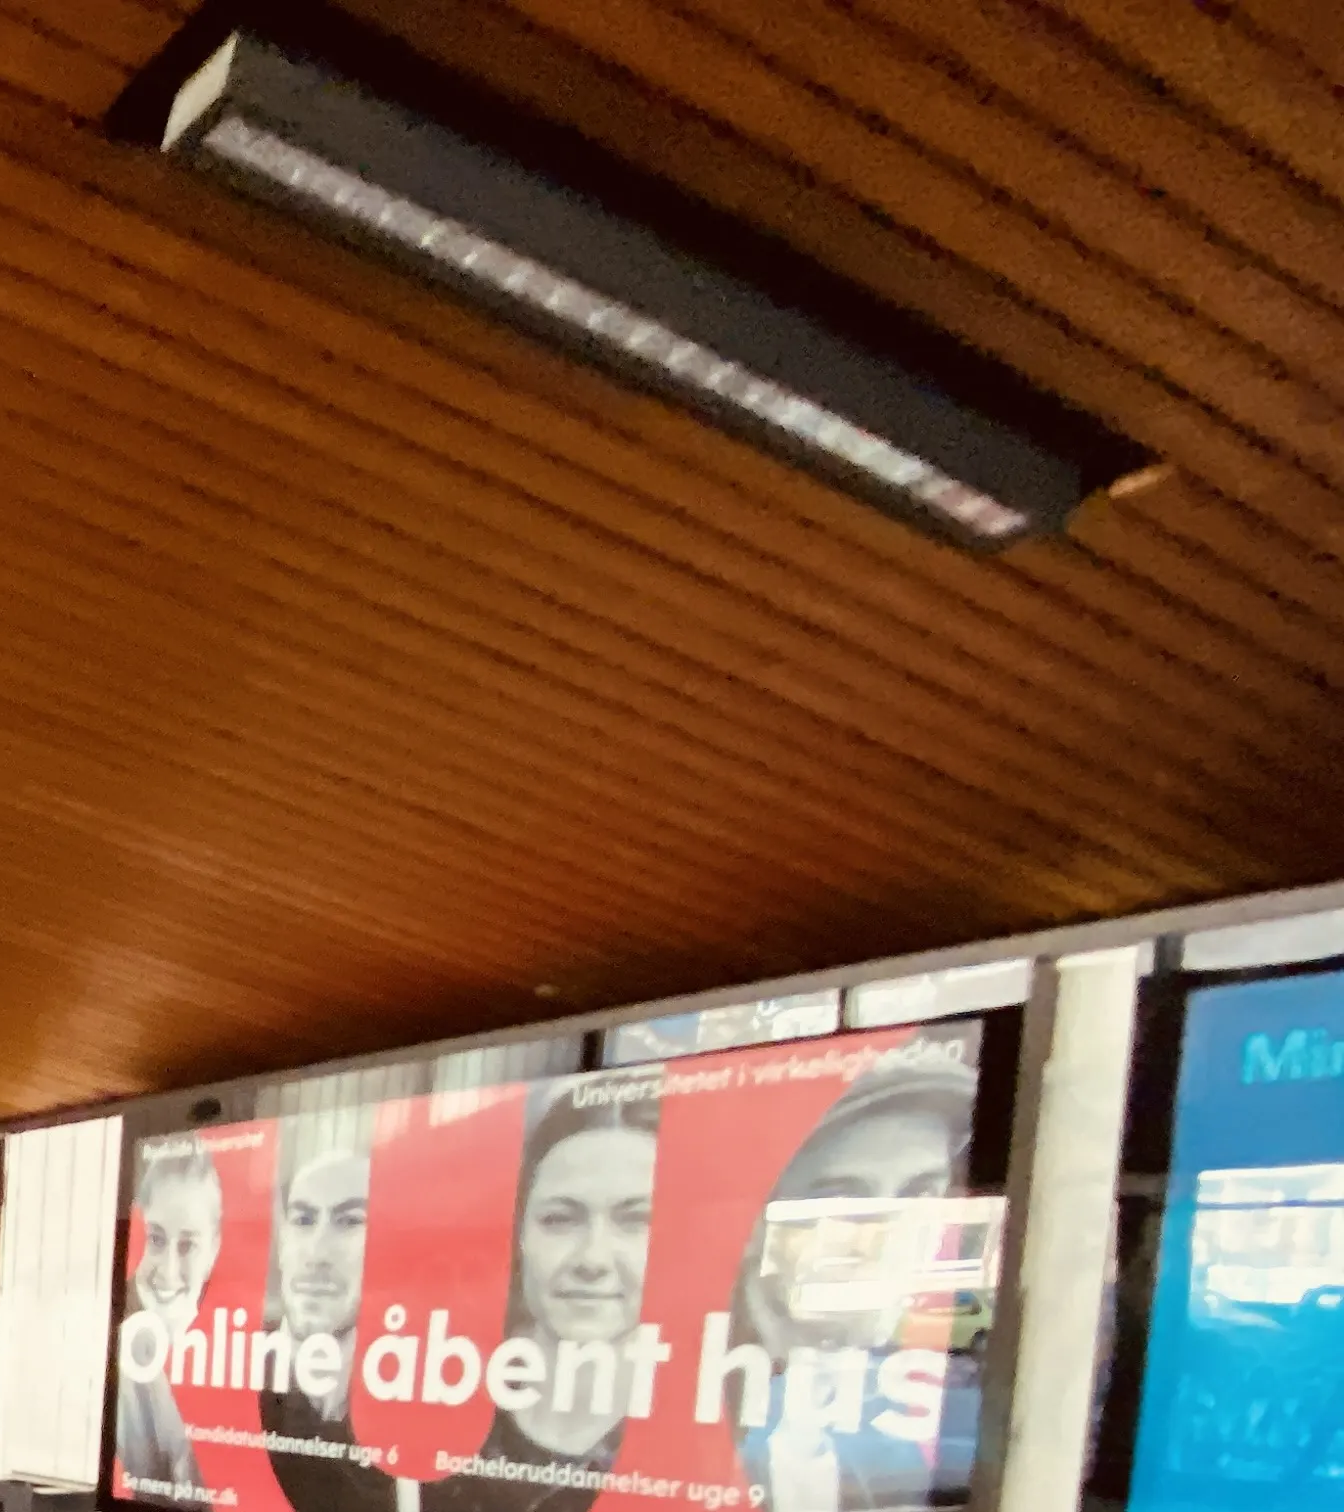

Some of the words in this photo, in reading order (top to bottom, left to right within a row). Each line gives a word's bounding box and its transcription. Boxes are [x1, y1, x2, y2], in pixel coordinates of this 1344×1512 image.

[119, 1307, 343, 1397] Online
[363, 1304, 673, 1418] åbent
[694, 1311, 949, 1442] hus
[184, 1424, 347, 1458] Kandidatuddannelser
[348, 1445, 382, 1467] uge
[386, 1444, 399, 1465] 6
[139, 1478, 172, 1494] mere
[174, 1480, 192, 1500] på
[435, 1450, 684, 1498] Bacheloruddannelser
[687, 1482, 741, 1510] uge
[748, 1484, 765, 1509] 9
